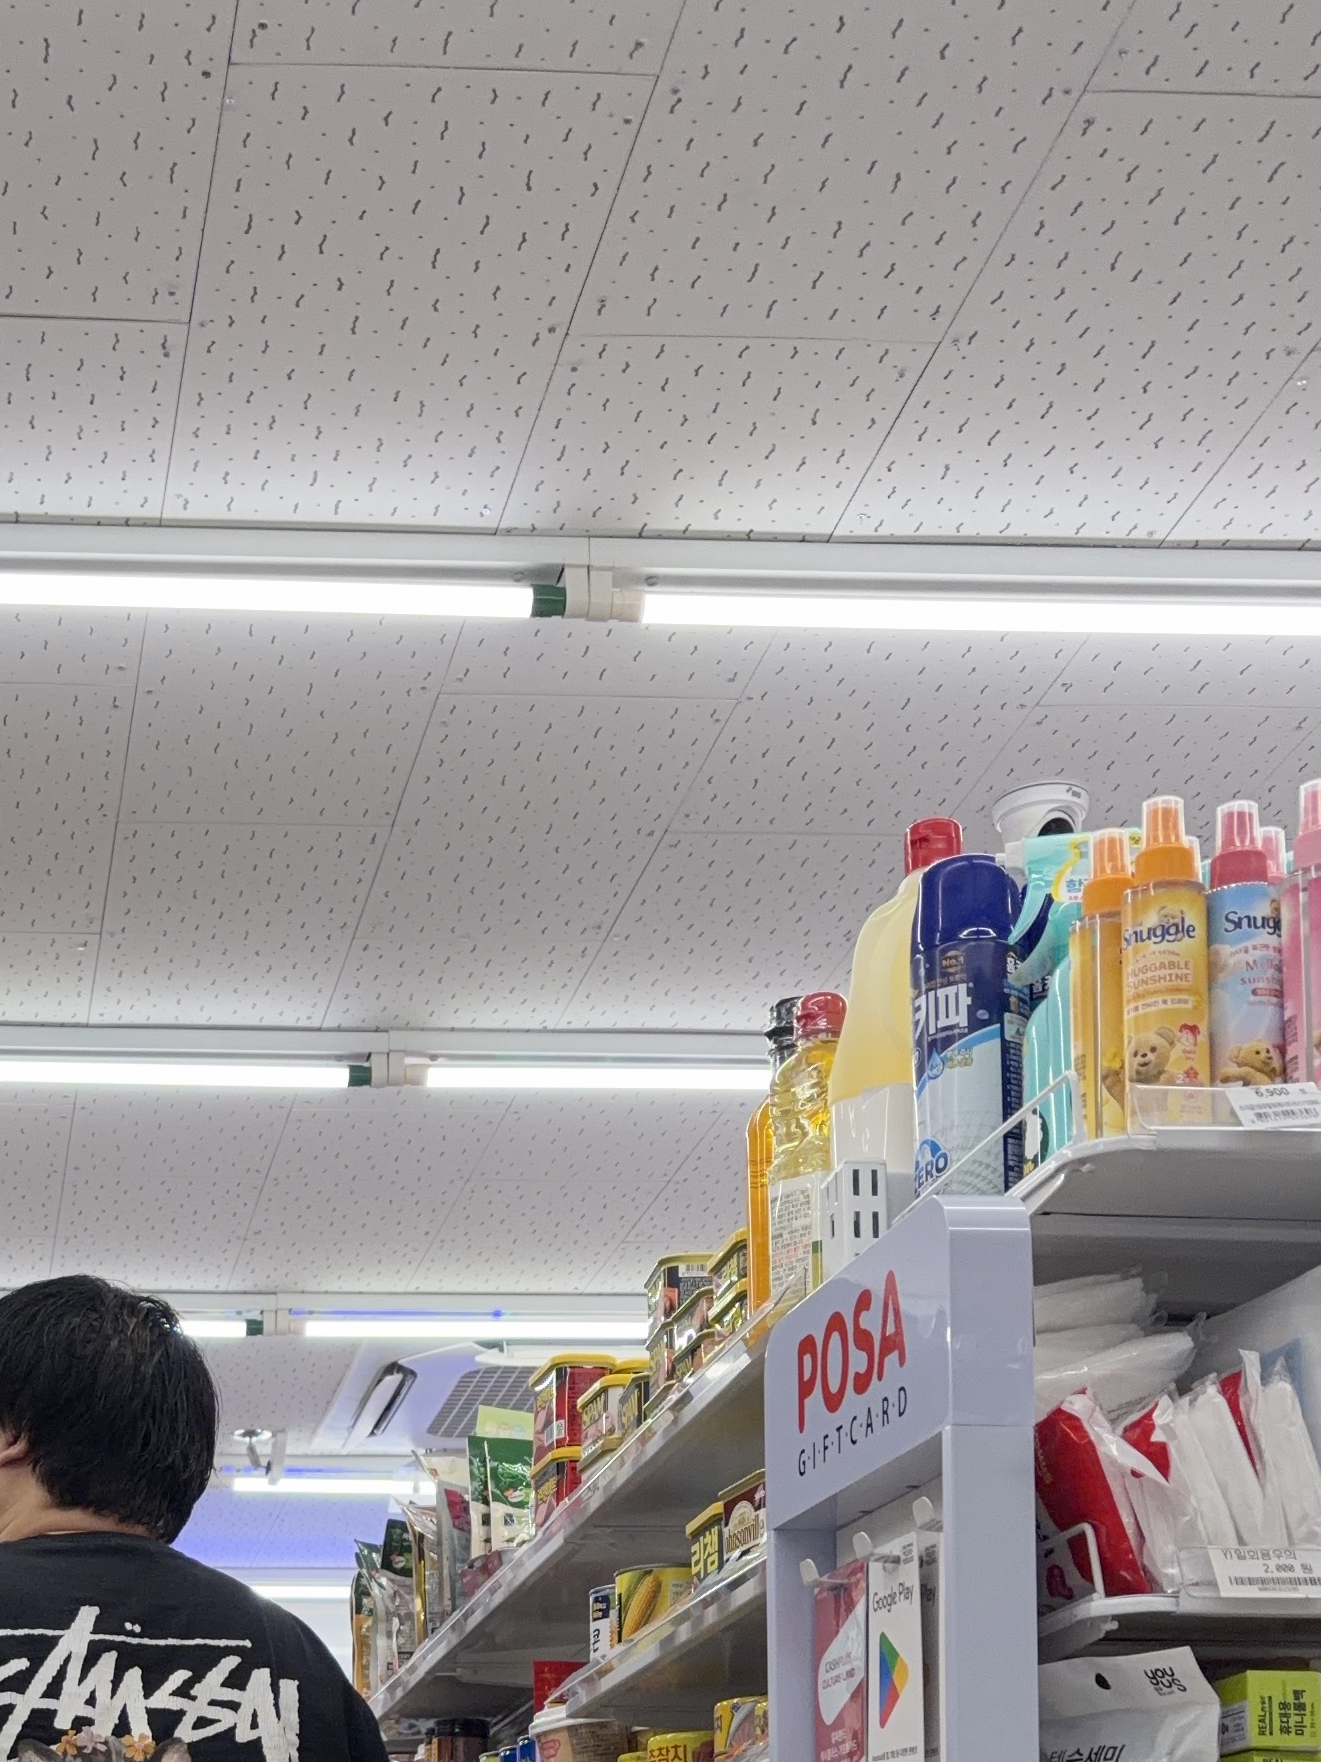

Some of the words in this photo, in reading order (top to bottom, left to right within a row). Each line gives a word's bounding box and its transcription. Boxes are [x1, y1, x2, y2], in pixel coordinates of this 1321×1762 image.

[1123, 914, 1197, 951] Snuggle
[1224, 910, 1282, 938] Snug
[1126, 959, 1191, 980] HUGGABLE
[1126, 972, 1192, 993] SUNSHINE
[915, 983, 972, 1042] 키파
[797, 1270, 907, 1434] POSA
[582, 1393, 605, 1427] SPAM
[691, 1525, 719, 1580] 리챔
[872, 1585, 898, 1614] Google
[898, 1582, 914, 1605] Play
[1278, 1699, 1292, 1736] 휴대용
